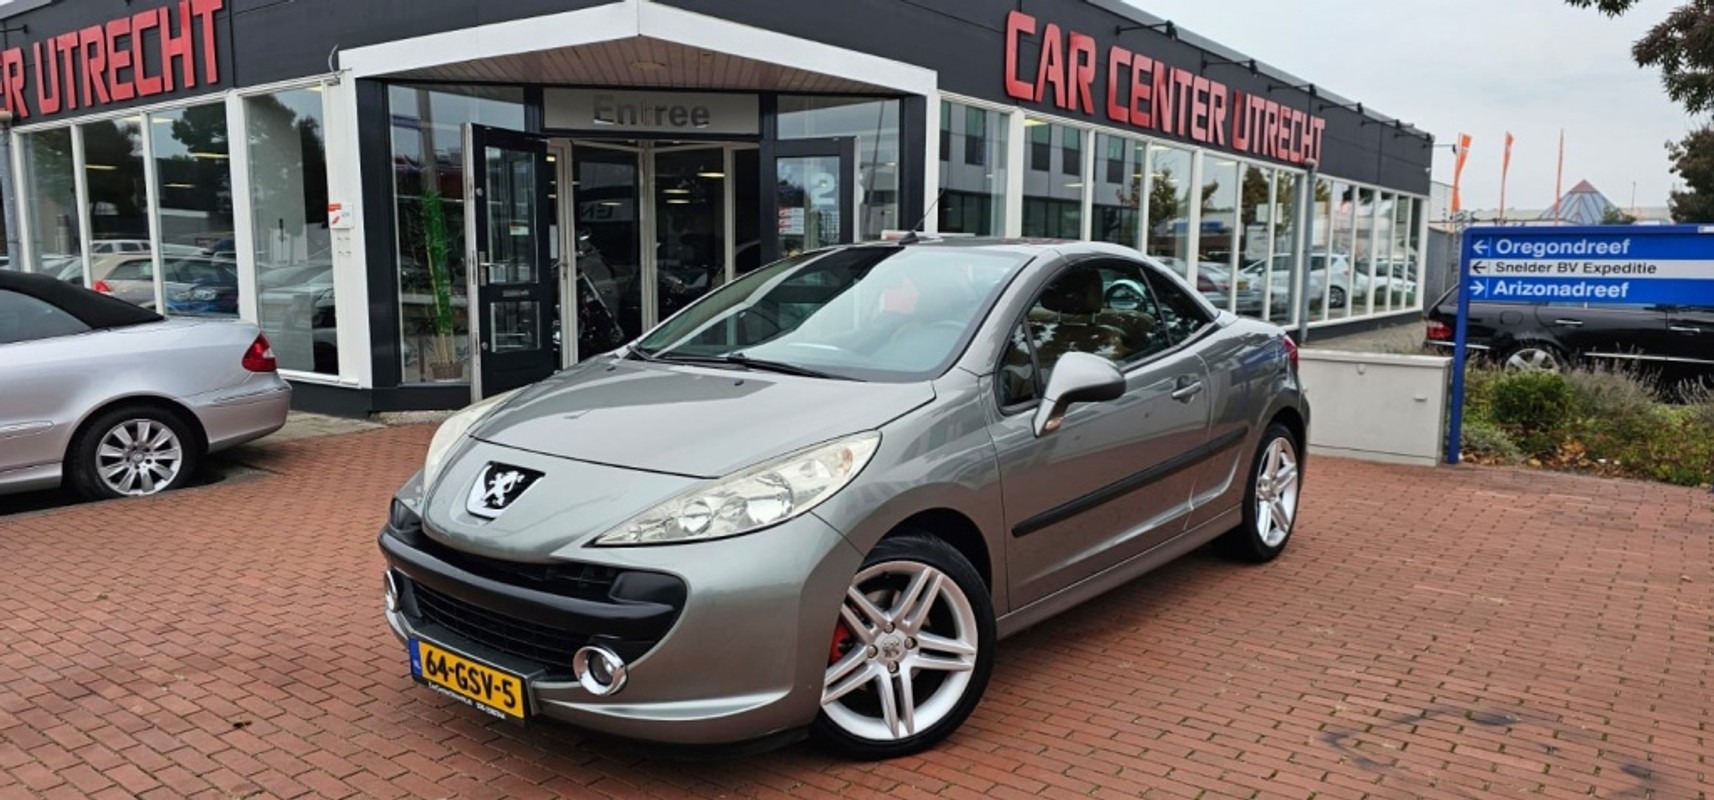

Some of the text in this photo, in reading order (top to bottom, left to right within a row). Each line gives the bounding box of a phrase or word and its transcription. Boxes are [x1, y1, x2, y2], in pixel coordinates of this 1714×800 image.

[0, 0, 223, 119] R UTRECHT
[1006, 10, 1325, 168] CAR CENTER UTRECHT
[593, 94, 710, 127] Entree
[1496, 239, 1631, 257] Oregondreef
[1495, 261, 1657, 276] Snelder BV Expeditie
[1493, 281, 1629, 298] Arizonadreef
[426, 650, 516, 709] 64-GSV-5
